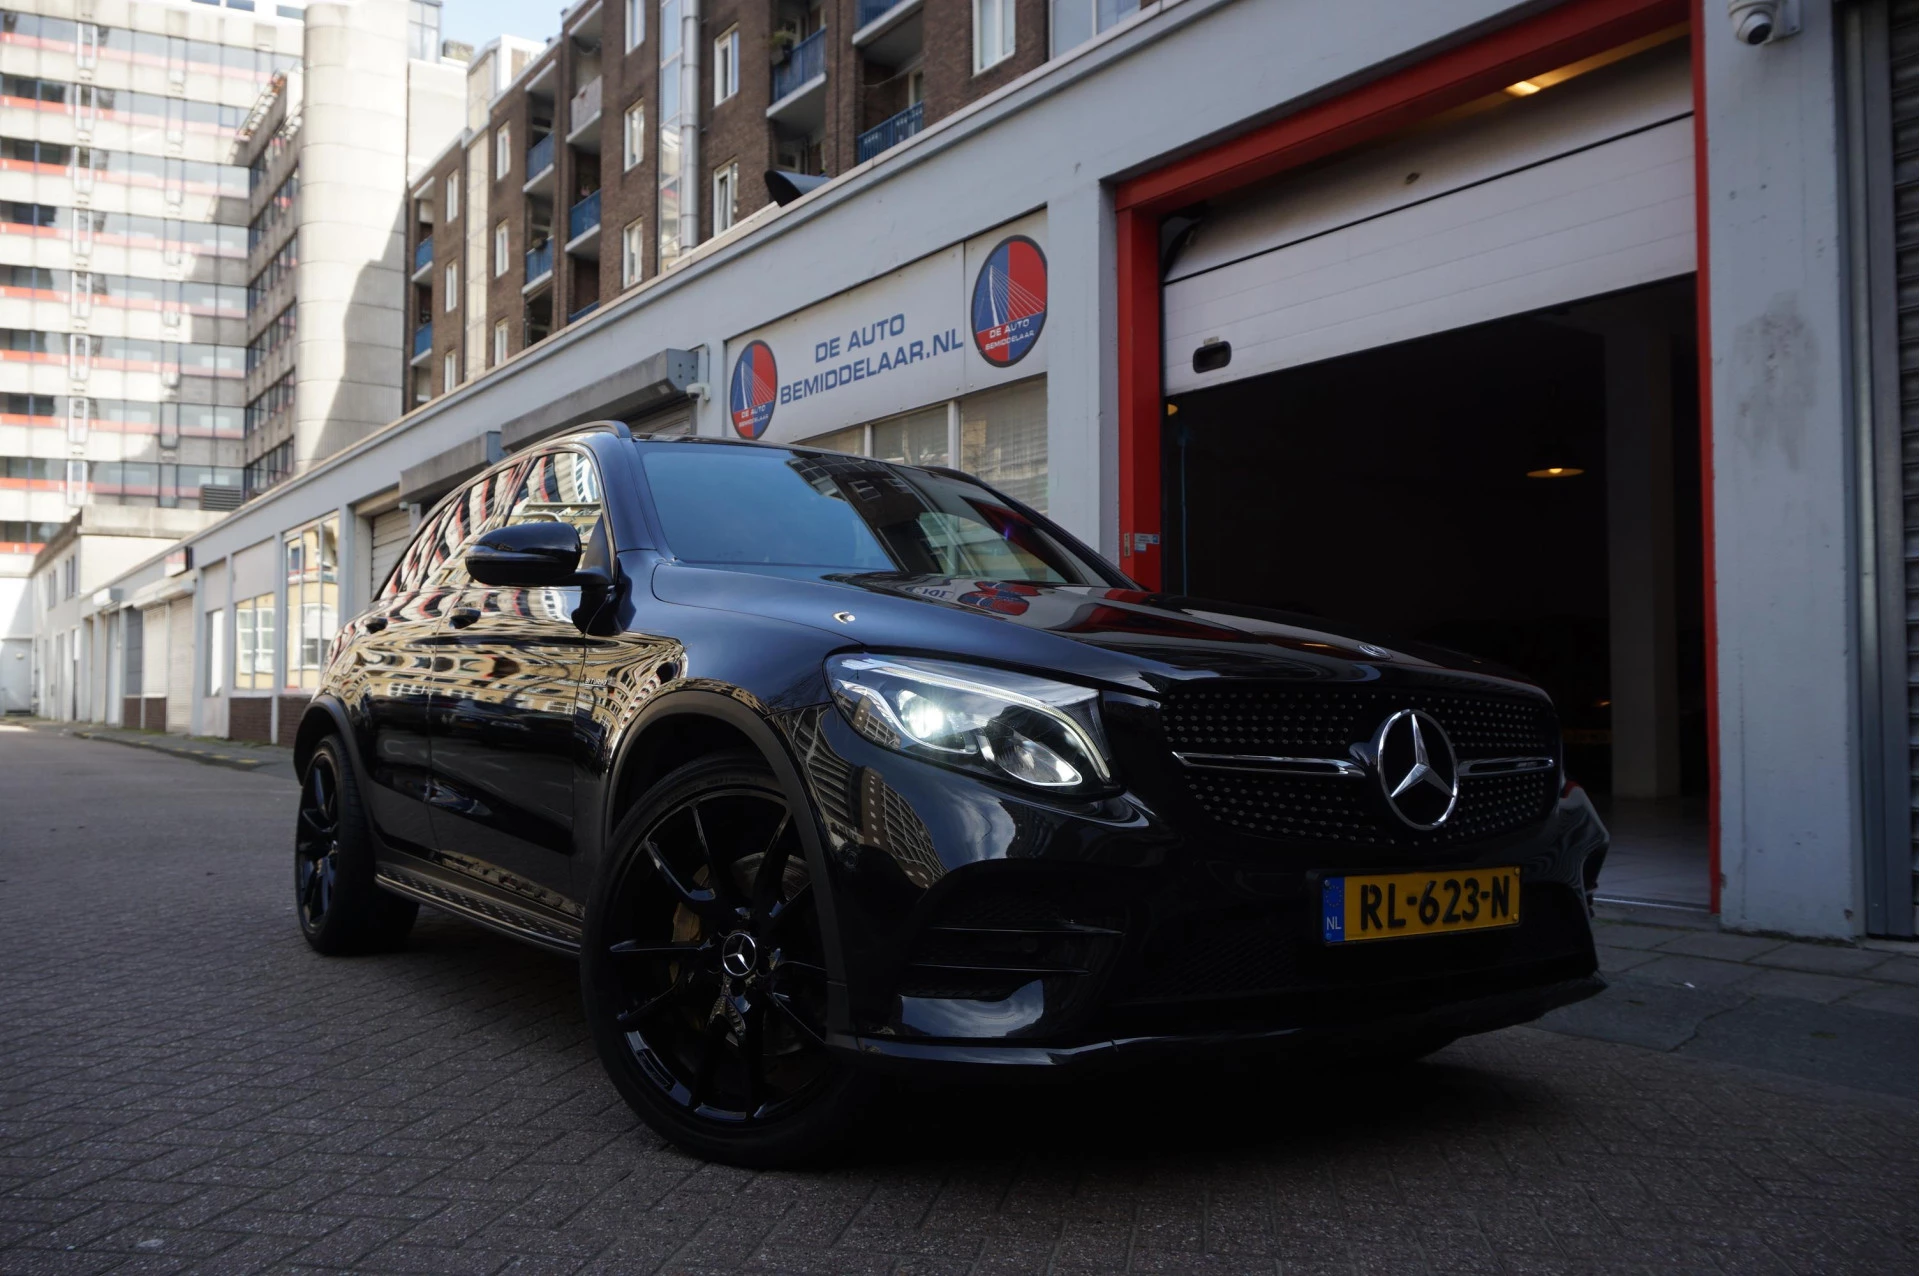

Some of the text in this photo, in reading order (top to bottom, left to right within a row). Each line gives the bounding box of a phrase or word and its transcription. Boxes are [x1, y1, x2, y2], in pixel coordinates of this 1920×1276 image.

[815, 313, 905, 364] DE AUTO
[989, 318, 1030, 339] DE AUTO
[780, 328, 964, 405] BEMIDDELAAR.NL
[1326, 916, 1342, 931] NL
[1360, 875, 1510, 931] RL-623-N
